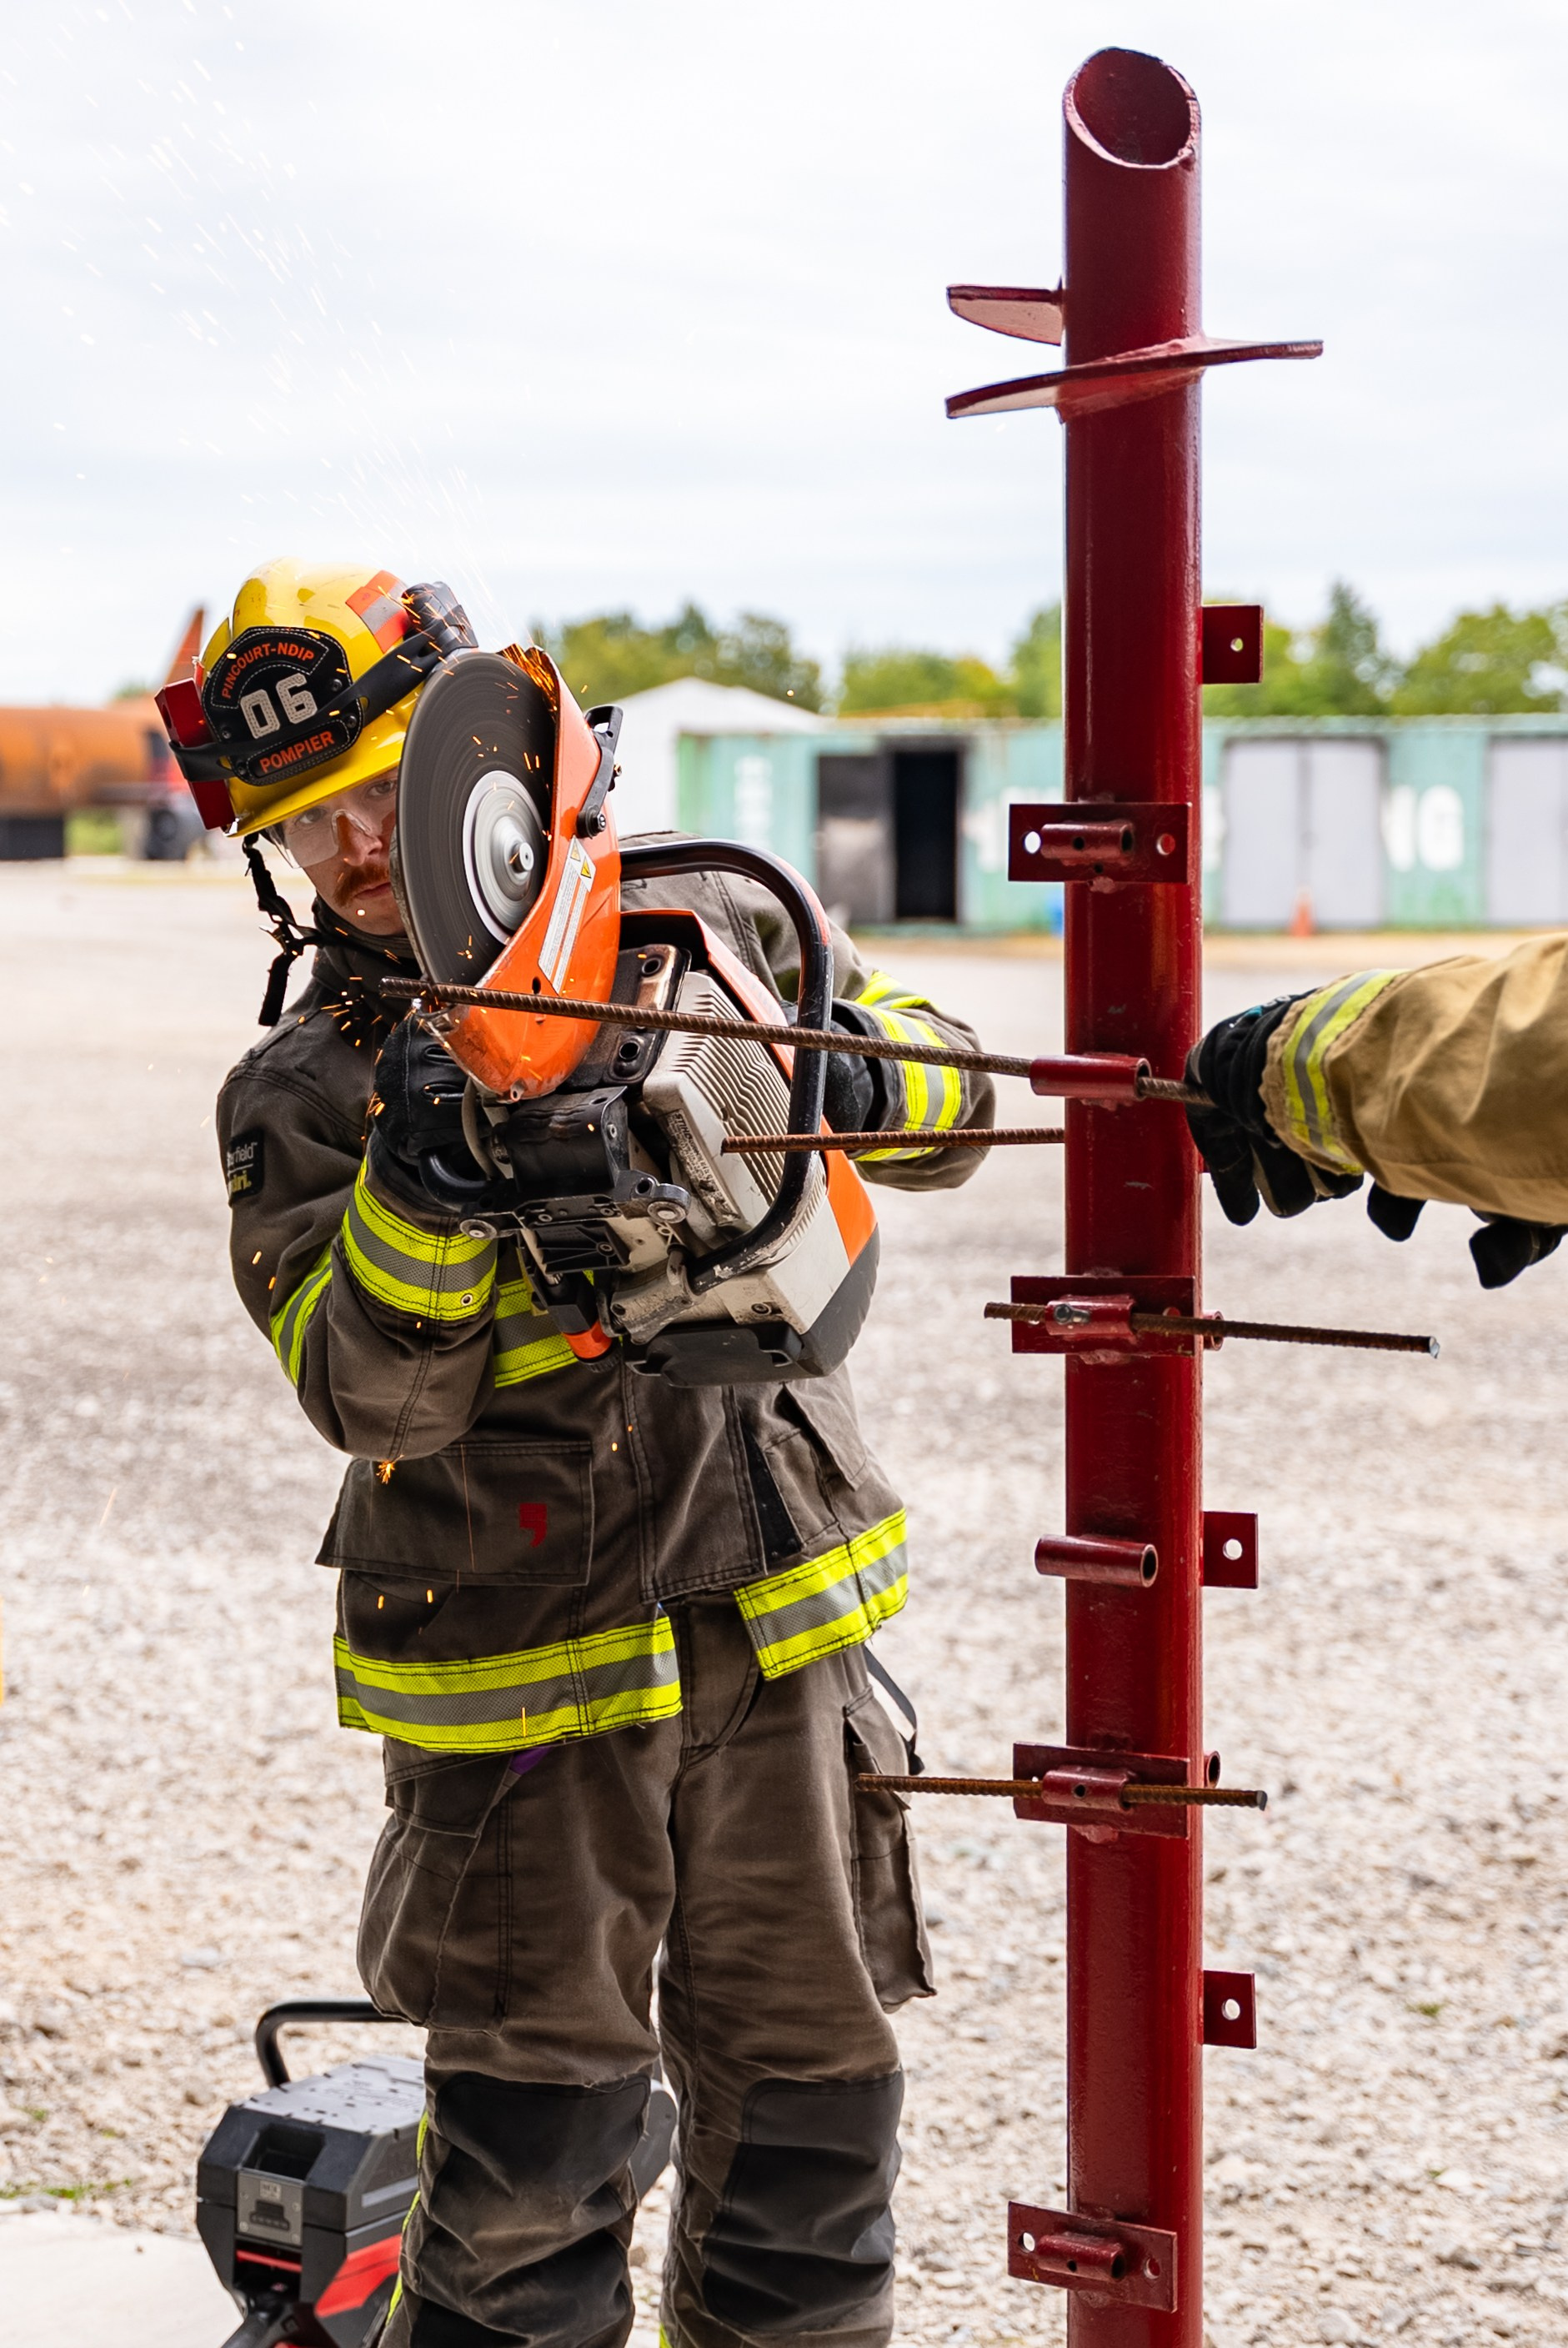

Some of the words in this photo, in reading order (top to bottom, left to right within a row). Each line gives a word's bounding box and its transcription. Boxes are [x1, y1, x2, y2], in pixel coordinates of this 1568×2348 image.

[222, 642, 314, 699] PINCOURT-NDIP
[240, 673, 318, 739] 06
[259, 730, 334, 774] POMPIER
